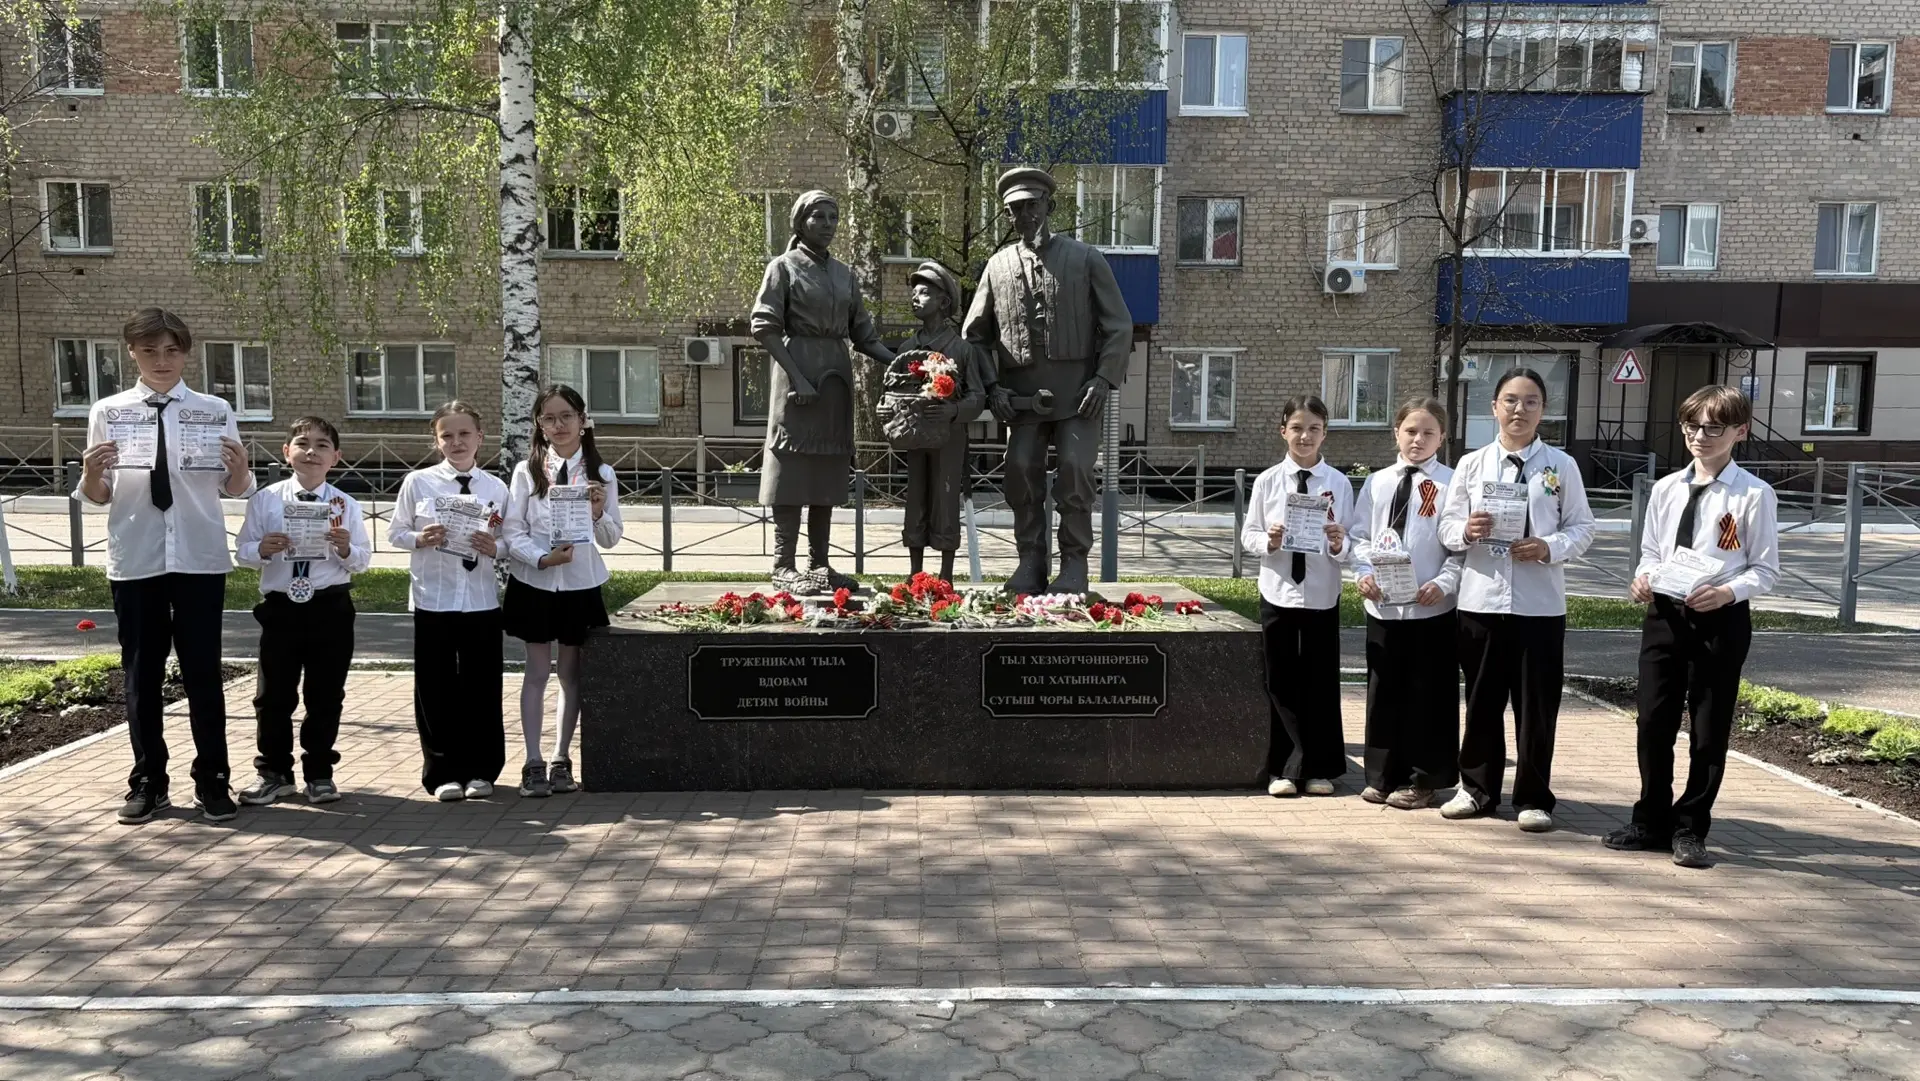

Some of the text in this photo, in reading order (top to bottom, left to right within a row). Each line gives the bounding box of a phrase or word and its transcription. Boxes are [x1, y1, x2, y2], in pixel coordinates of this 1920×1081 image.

[1625, 366, 1634, 378] У
[720, 656, 846, 667] ТРУЖЕНИКАМ ТЫЛА
[999, 655, 1149, 665] ТЫЛ ХЕЗМӘТЧӘННӘРЕНӘ
[759, 677, 808, 687] ВДОВАМ
[1021, 675, 1127, 685] ТОЛ ХАТЫННАРГА
[737, 695, 829, 708] ДЕТЯМ ВОЙНЫ
[989, 695, 1159, 705] СУГЫШ ЧОРЫ БАЛАЛАРЫНА
